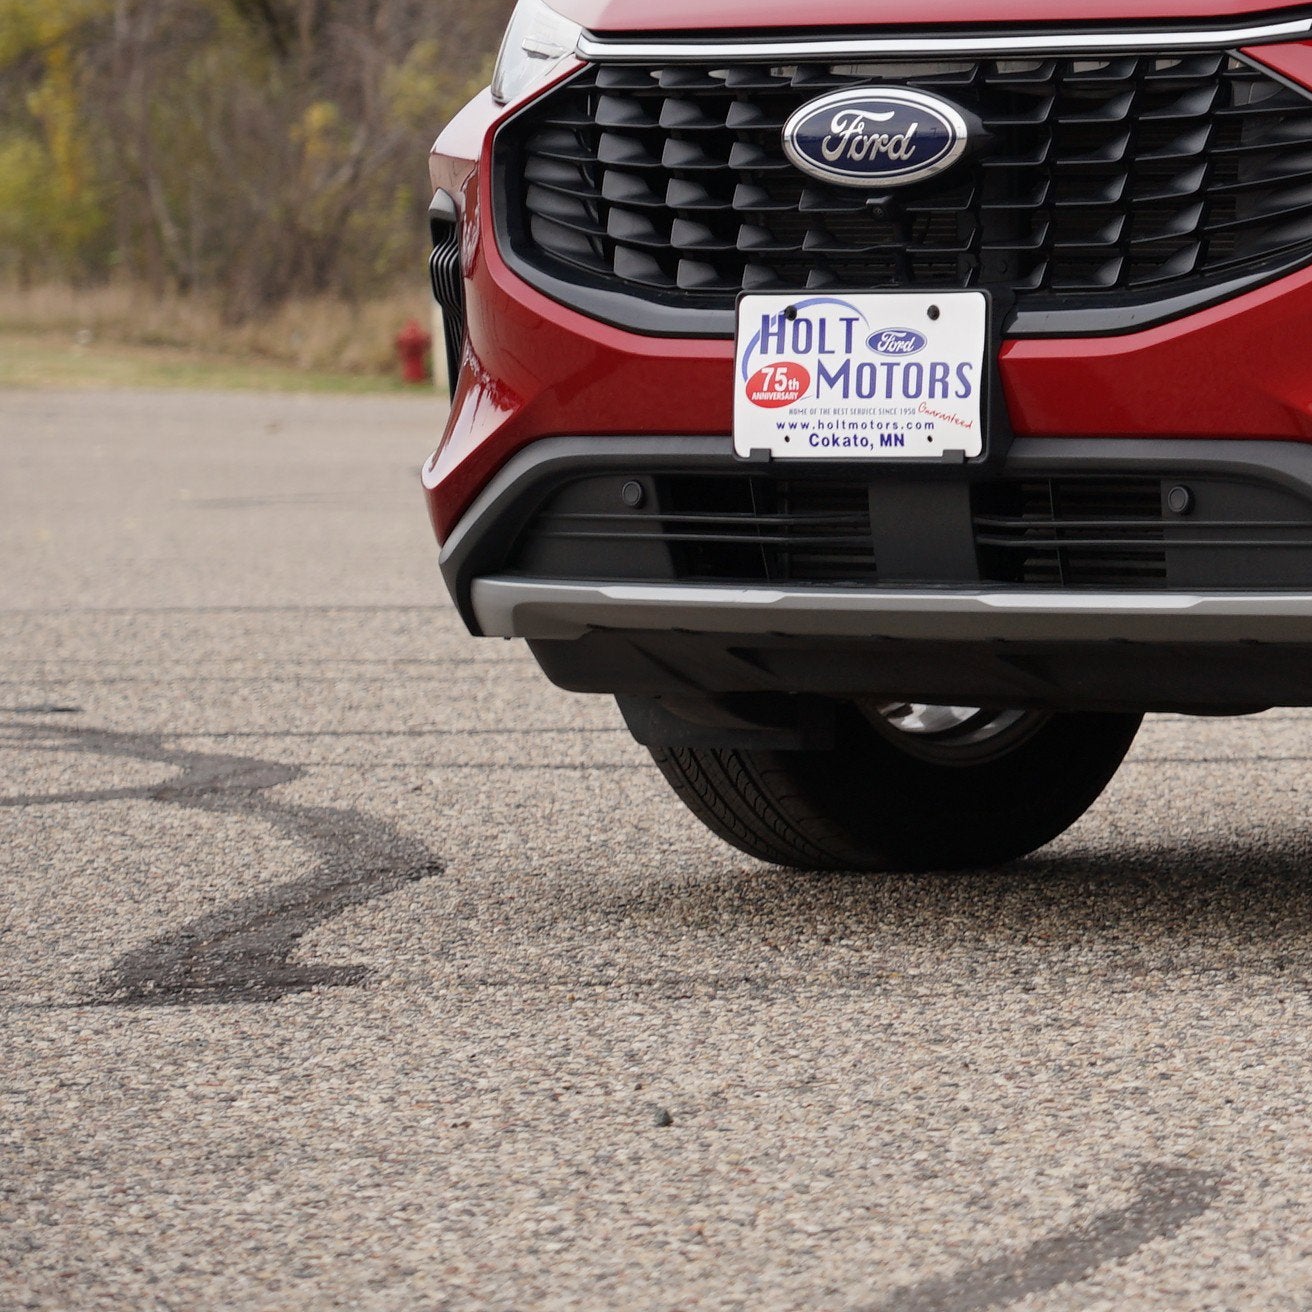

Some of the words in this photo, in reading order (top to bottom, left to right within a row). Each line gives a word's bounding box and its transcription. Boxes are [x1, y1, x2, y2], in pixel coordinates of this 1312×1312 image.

[821, 108, 919, 162] Ford
[759, 314, 860, 356] HOLT
[876, 331, 916, 353] Ford
[761, 367, 800, 392] 75th
[816, 358, 974, 400] MOTORS
[751, 391, 799, 401] ANNIVERSARY
[788, 407, 809, 416] HOME
[809, 407, 818, 416] OF
[819, 407, 832, 416] THE
[833, 407, 849, 416] BEST
[878, 407, 897, 416] SINCE
[917, 401, 974, 430] Guaranteed
[775, 419, 935, 431] www.holtmotors.com
[808, 433, 875, 450] Cokato,
[880, 433, 905, 448] MN
